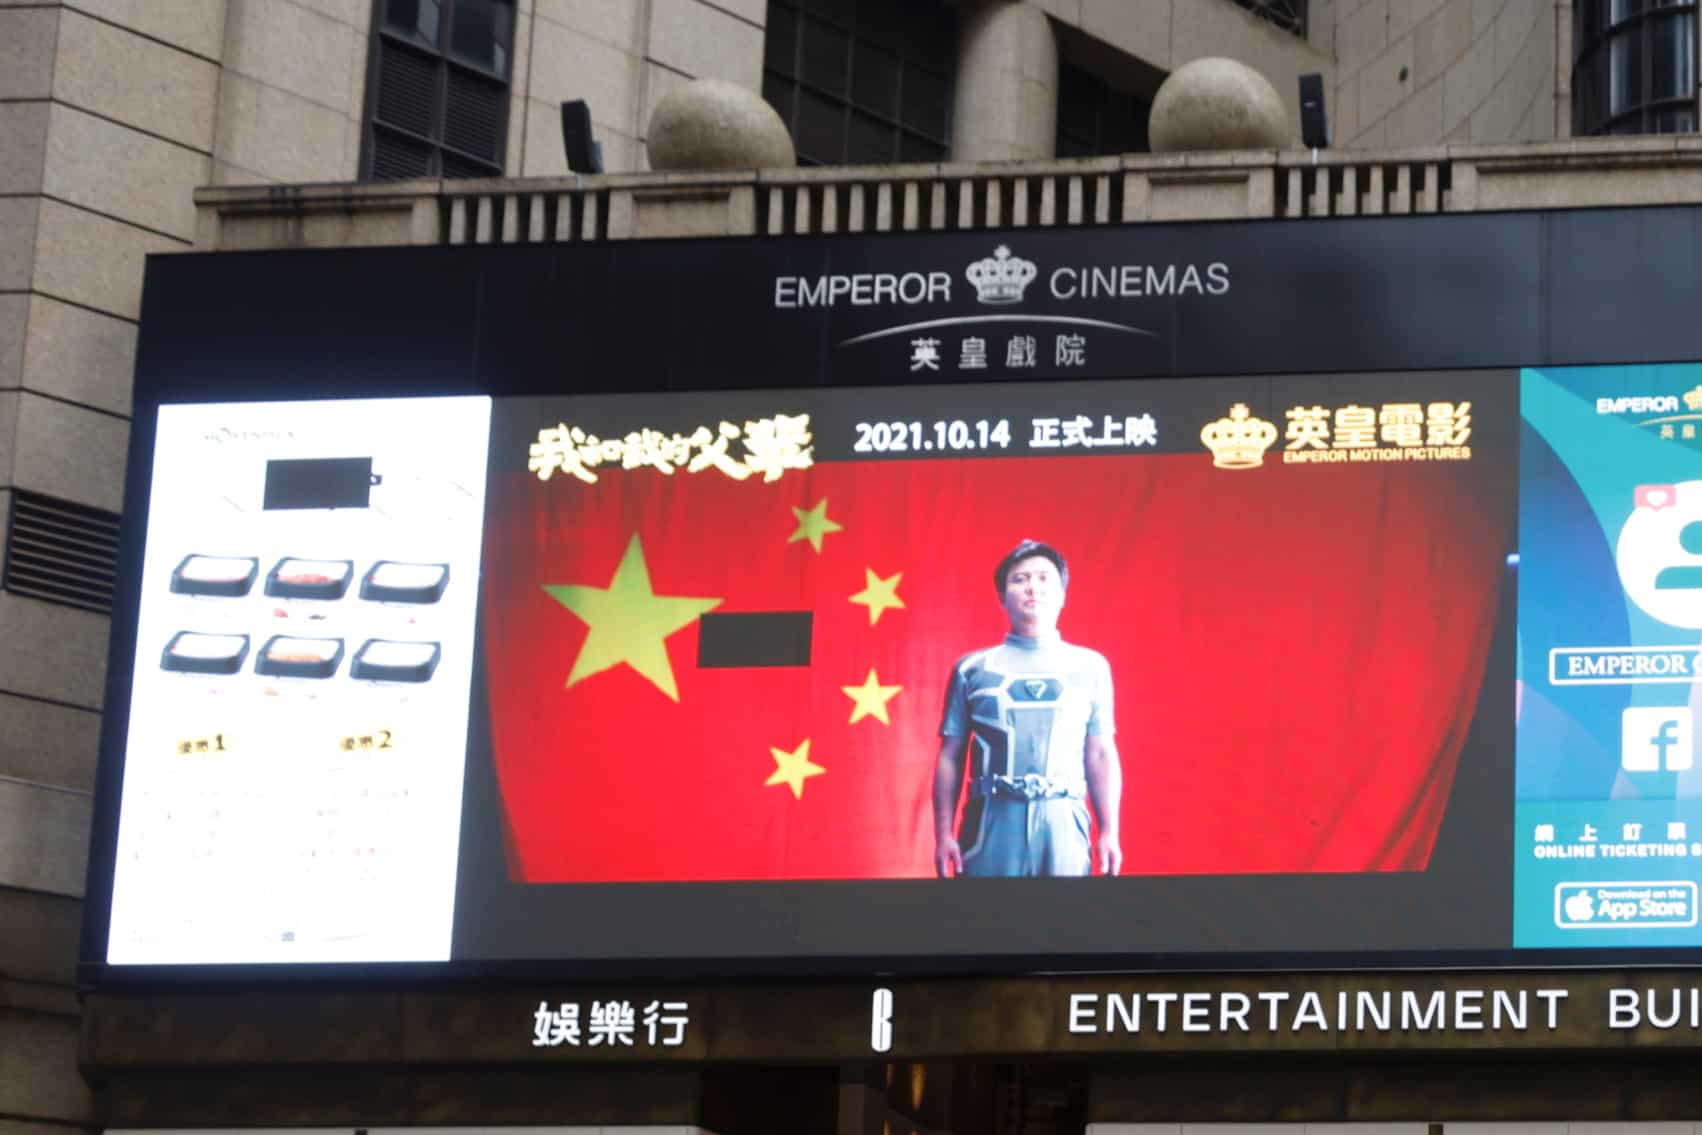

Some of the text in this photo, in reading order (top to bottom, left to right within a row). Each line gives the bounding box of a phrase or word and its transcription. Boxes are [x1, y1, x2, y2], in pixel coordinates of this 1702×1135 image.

[775, 262, 1231, 308] EMPEROR CINEMAS
[909, 334, 1087, 372] 英皇戲院
[1596, 396, 1679, 414] EMPEROR
[853, 413, 1158, 452] 2021.10.14 正式上映
[1284, 402, 1472, 450] 英皇電影
[1282, 446, 1472, 464] EMPEROR MOTION PICTURES
[1568, 653, 1688, 676] EMPEROR
[1534, 844, 1596, 858] ONLINE
[1599, 843, 1687, 857] TICKETING
[1598, 899, 1687, 919] App Store
[532, 1000, 689, 1046] 娛樂行
[1067, 989, 1569, 1033] ENTERTAINMENT
